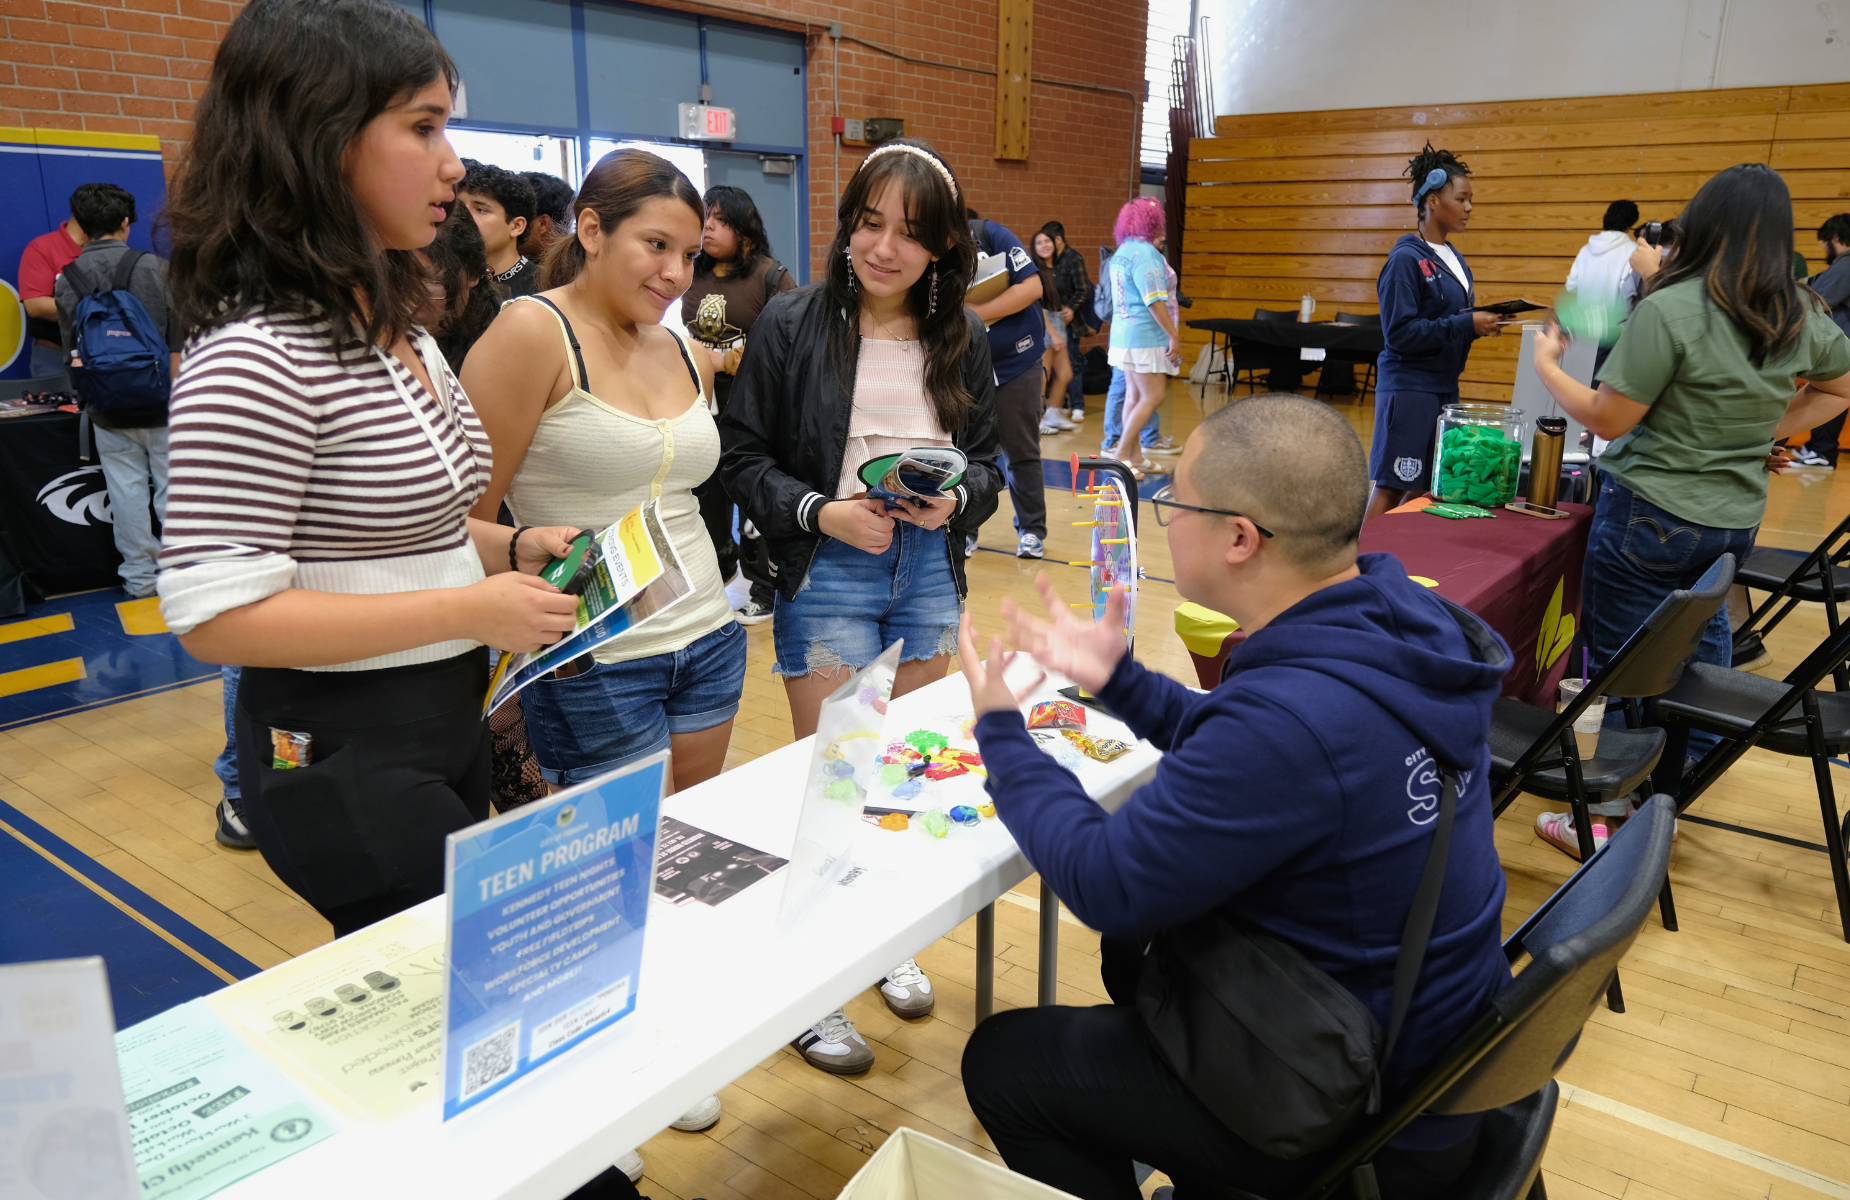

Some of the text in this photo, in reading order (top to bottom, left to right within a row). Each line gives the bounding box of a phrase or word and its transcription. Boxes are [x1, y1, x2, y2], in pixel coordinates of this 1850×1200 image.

[707, 110, 728, 135] EXIT
[612, 553, 629, 587] EVENTS
[1405, 746, 1426, 766] CITY
[478, 859, 534, 901] TEEN
[540, 813, 640, 875] PROGRAM
[487, 904, 549, 940] VOLUNTEER
[550, 867, 626, 910] OPPORTUNITIES
[502, 857, 616, 917] KENNEDY TEEN NIGHTS
[490, 885, 621, 955] YOUTH AND GOVERNMENT
[484, 915, 621, 991] WORKFORCE DEVELOPMENT
[508, 942, 598, 995] SPECIALTY CAMPS
[522, 985, 546, 1003] AND
[326, 1011, 398, 1047] LOCATION
[348, 998, 409, 1028] PALOMARES
[412, 1020, 441, 1039] ers
[341, 1035, 415, 1075] Needed
[143, 1092, 211, 1123] October
[200, 1089, 245, 1117] FREE
[167, 1117, 243, 1153] Workforce
[168, 1127, 260, 1176] Kennedy
